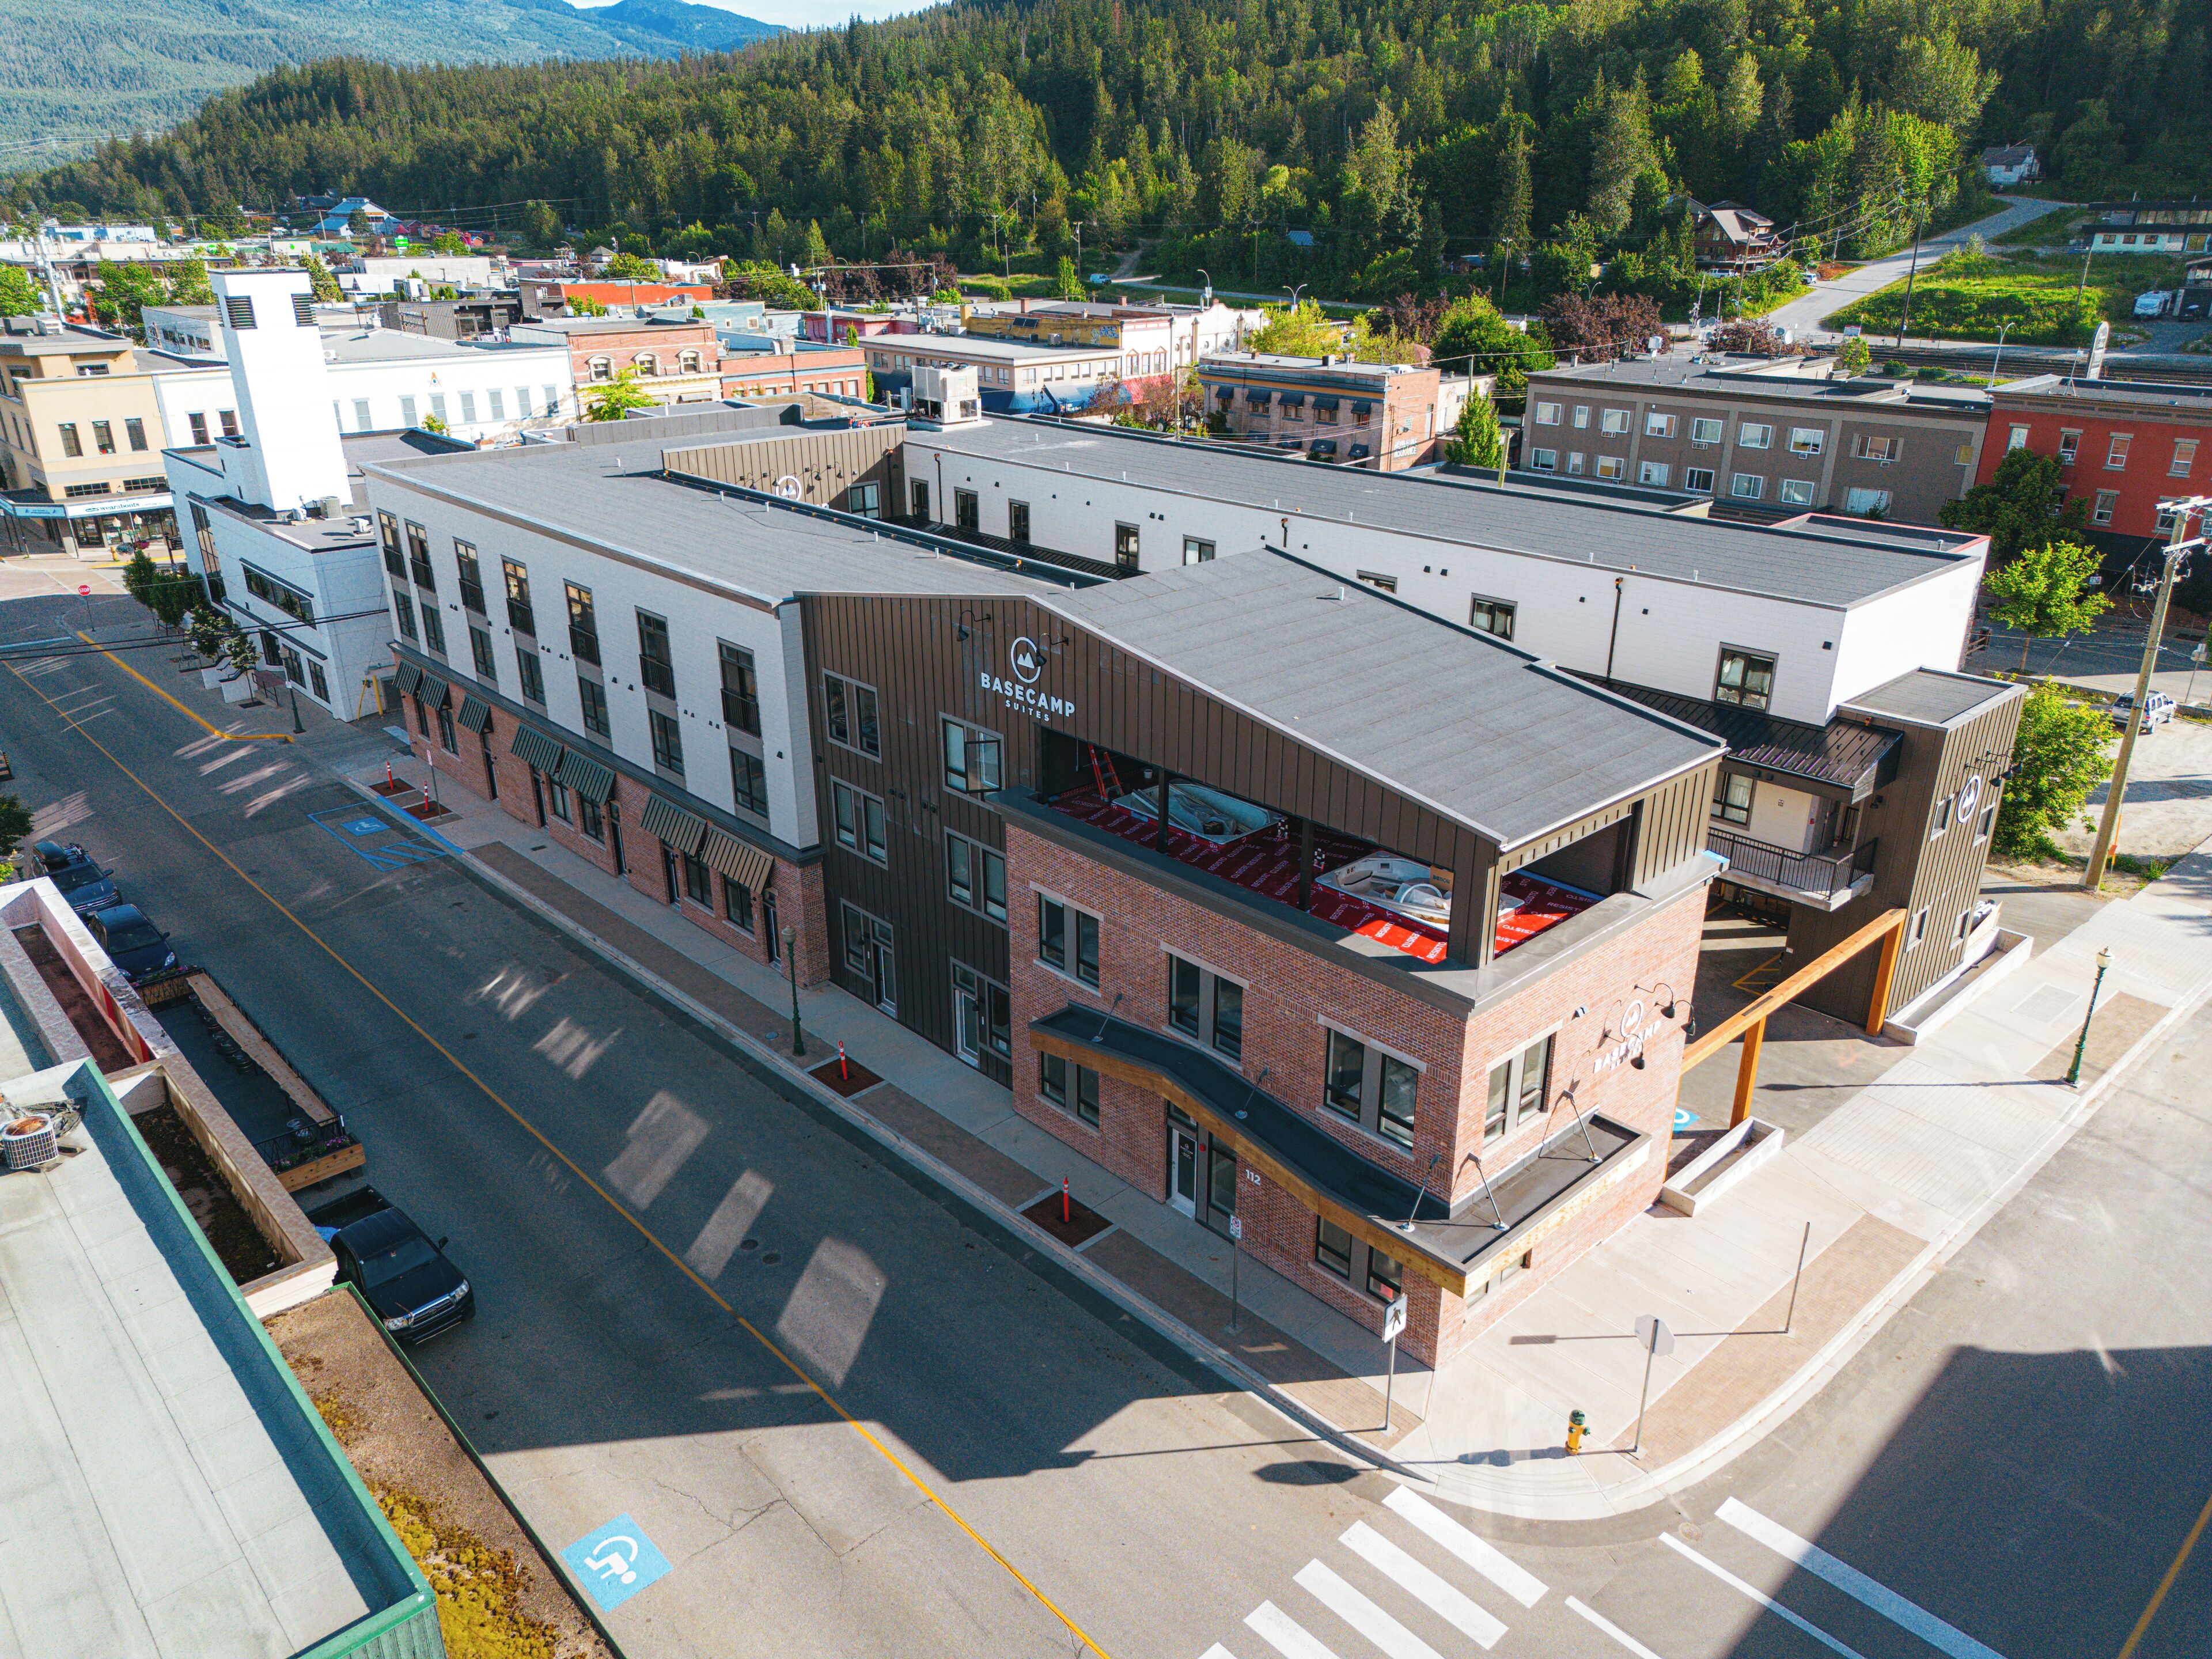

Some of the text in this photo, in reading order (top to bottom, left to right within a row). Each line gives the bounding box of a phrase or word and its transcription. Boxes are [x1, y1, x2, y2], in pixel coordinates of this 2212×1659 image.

[100, 502, 139, 510] wearabouts
[981, 672, 1075, 717] BASECAMP
[1005, 700, 1050, 722] SUITES
[1330, 903, 1349, 921] RESISTO
[1375, 921, 1395, 938] RESISTO
[1402, 930, 1422, 948] RESISTO
[1426, 941, 1446, 959] RESISTO
[1245, 1169, 1261, 1186] 112
